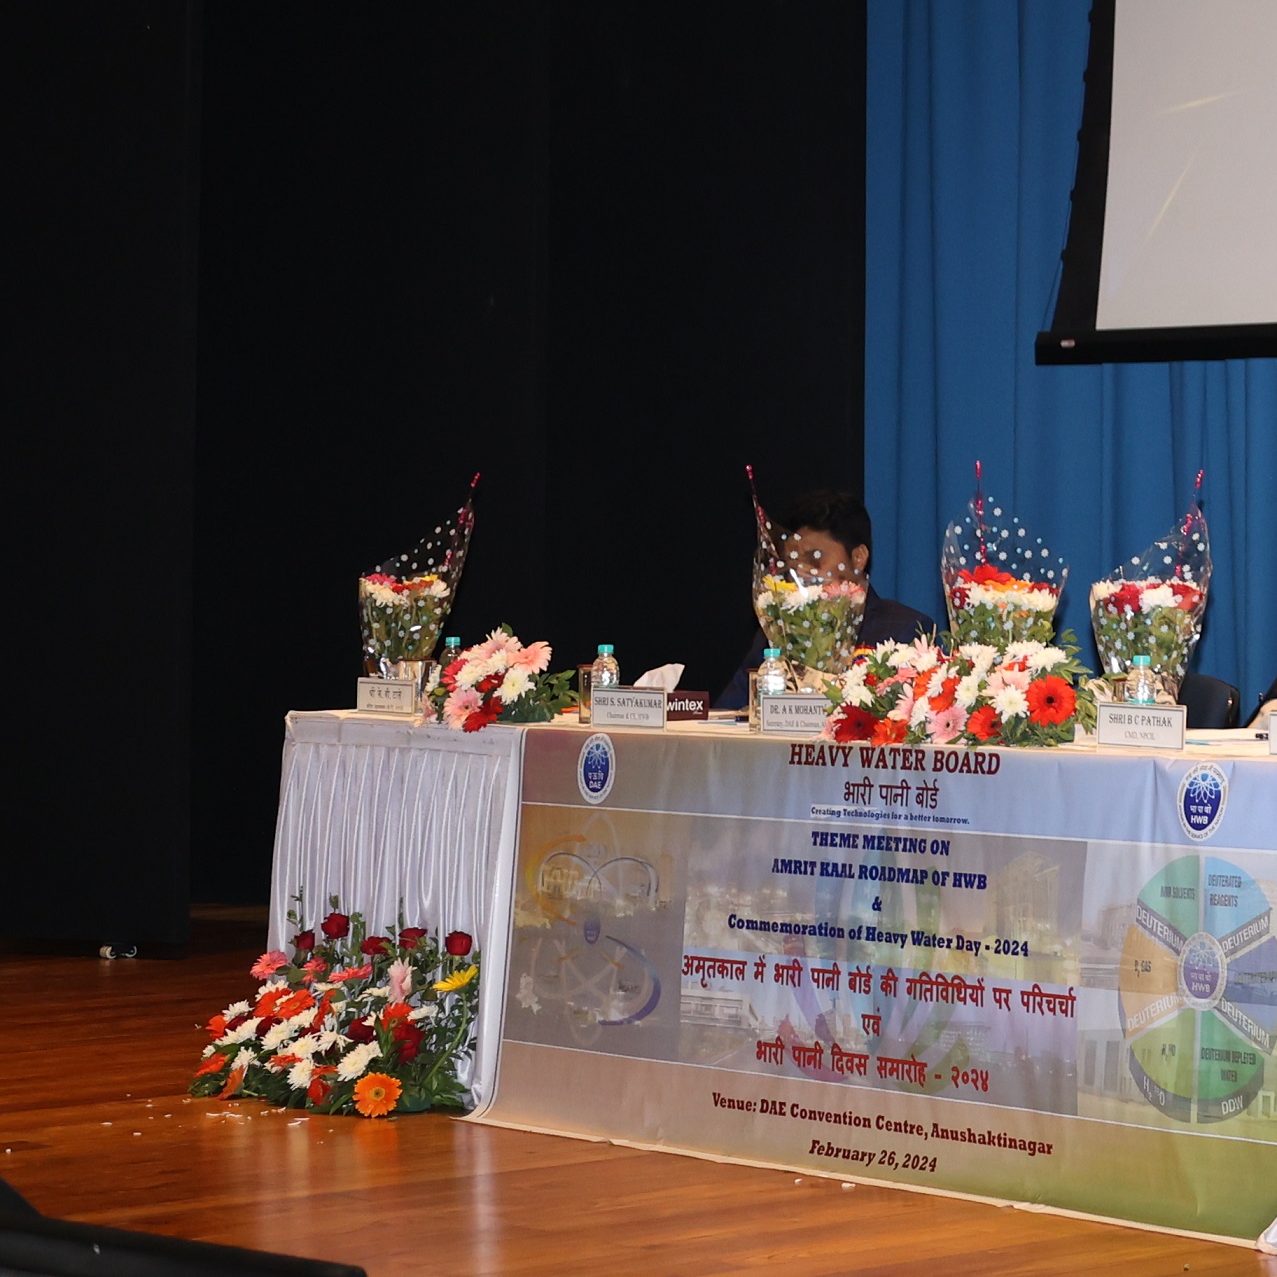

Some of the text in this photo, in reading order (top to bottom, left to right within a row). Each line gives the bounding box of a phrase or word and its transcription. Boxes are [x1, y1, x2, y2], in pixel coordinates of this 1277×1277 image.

[770, 704, 779, 714] DR.
[781, 705, 787, 714] A
[788, 705, 794, 714] K
[1108, 713, 1173, 728] SHRI B C PATHAK
[789, 743, 1001, 775] HEAVY WATER BOARD
[843, 776, 940, 809] भारी पानी बोर्ड
[811, 806, 970, 825] Creating Technologies for a better tomorrow.
[1190, 815, 1209, 825] HWB
[811, 831, 951, 856] THEME MEETING ON
[772, 858, 988, 890] AMRIT KAAL ROADMAP OF HWB
[872, 896, 883, 912] &
[728, 913, 845, 940] Commemoration
[848, 925, 864, 941] of
[865, 926, 908, 949] Heavy
[911, 930, 953, 950] Water
[956, 934, 982, 957] Day
[994, 939, 1029, 957] 2024
[1136, 905, 1184, 953] DEUTERIUM
[1222, 916, 1270, 953] DEUTERIUM
[681, 954, 1077, 1018] अमृतकाल में भारी पानी बोर्ड की गतिविधियों पर परिचर्चा
[1191, 981, 1211, 993] HWB
[861, 1006, 882, 1037] एवं
[1128, 992, 1183, 1029] DEUTERIUM
[1221, 998, 1270, 1047] DEUTERIUM
[756, 1040, 785, 1065] भारी
[792, 1042, 823, 1070] पानी
[831, 1043, 868, 1076] दिवस
[876, 1053, 928, 1087] समारोह
[951, 1066, 990, 1093] २०२४
[1221, 1095, 1243, 1115] DDW
[712, 1092, 1053, 1157] Venue: DAE Convention Centre, Anushaktinagar
[809, 1139, 938, 1173] February 26, 2024
